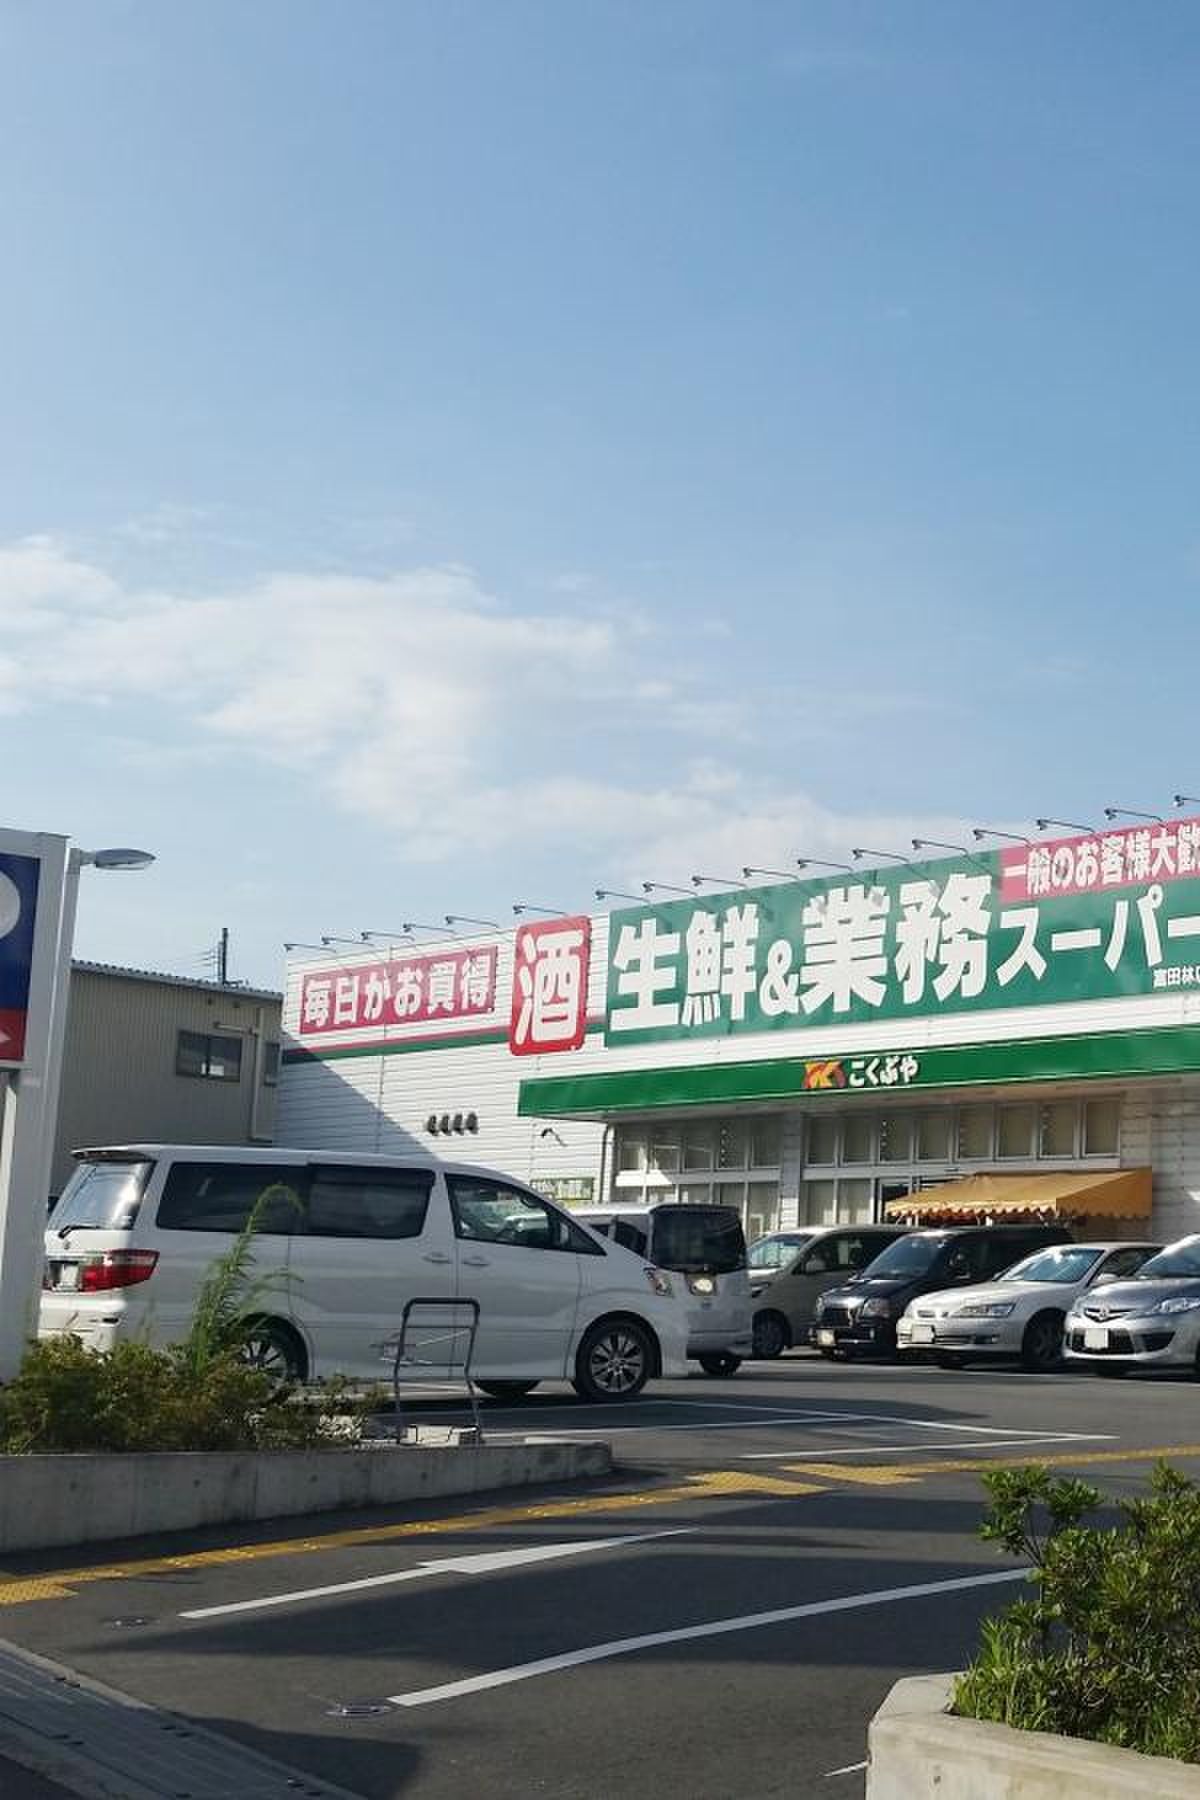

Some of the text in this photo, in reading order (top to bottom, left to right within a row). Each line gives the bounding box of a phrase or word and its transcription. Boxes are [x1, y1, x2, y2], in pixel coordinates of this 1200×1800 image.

[514, 930, 584, 1044] 酒
[848, 1056, 918, 1087] こくぶや
